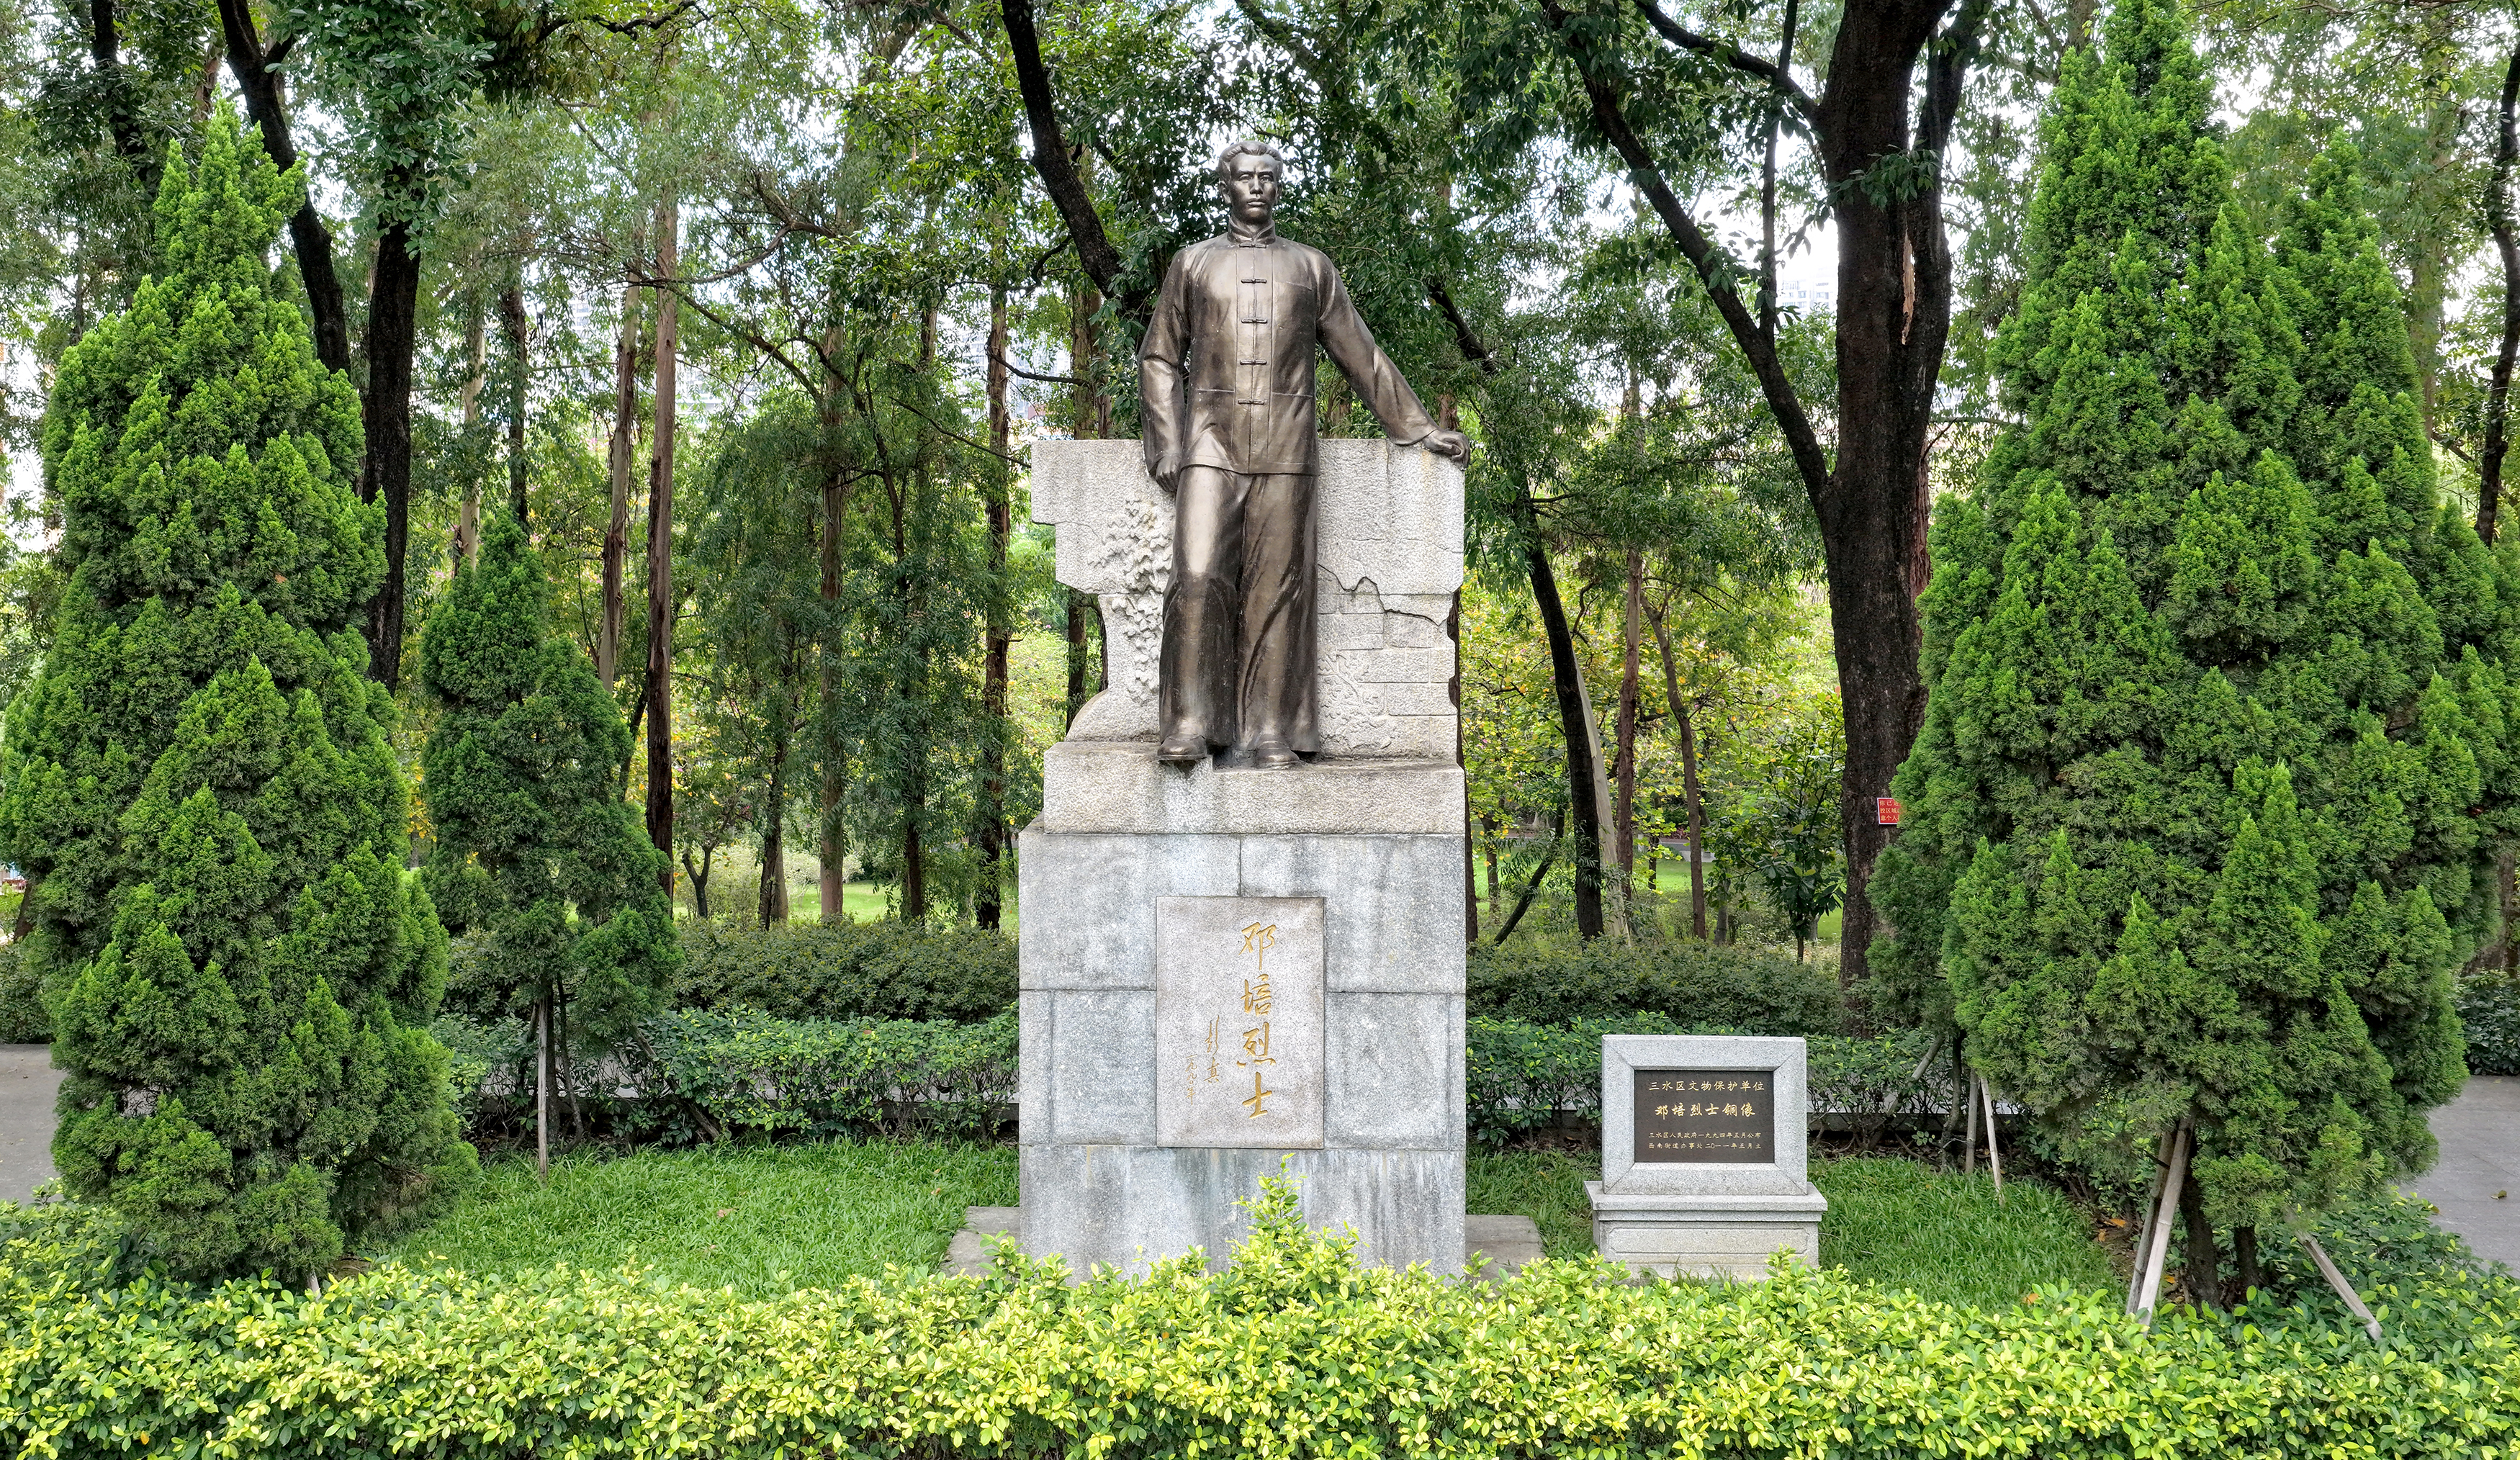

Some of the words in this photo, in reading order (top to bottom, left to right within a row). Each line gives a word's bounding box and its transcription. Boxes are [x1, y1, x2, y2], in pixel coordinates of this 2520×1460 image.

[1237, 921, 1277, 1119] 邓培烈士
[1649, 1081, 1765, 1091] 三水区文物保护单位
[1655, 1102, 1755, 1119] 邓培烈士铜像
